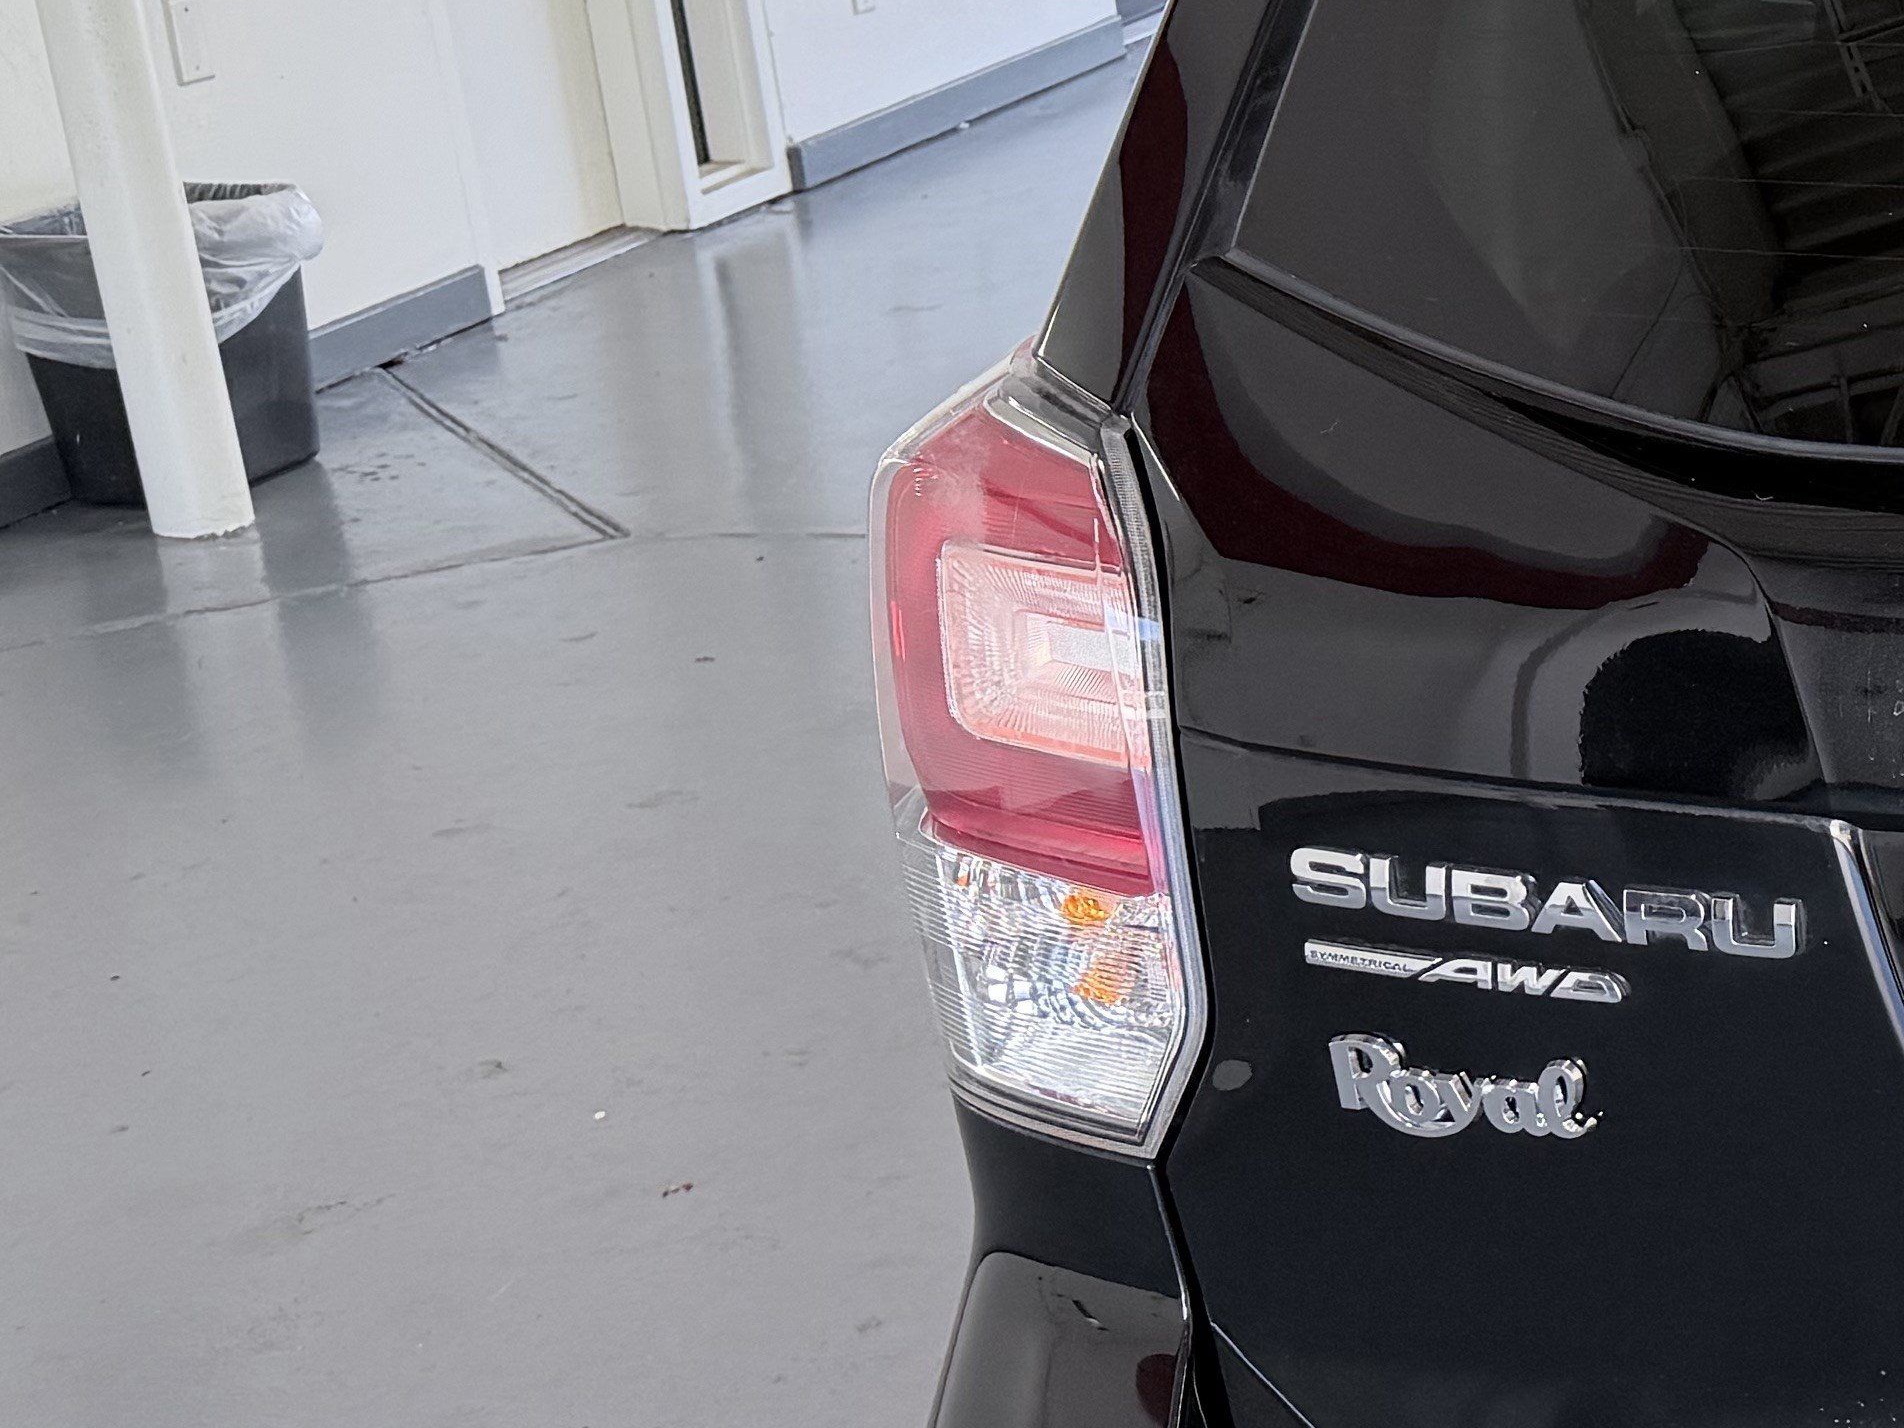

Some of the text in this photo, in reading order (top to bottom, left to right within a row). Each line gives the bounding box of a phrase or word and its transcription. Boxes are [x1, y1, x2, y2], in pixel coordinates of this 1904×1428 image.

[1289, 846, 1808, 960] SUBARU
[1308, 949, 1632, 1004] SYMMETRICAL AWD
[1328, 1031, 1605, 1140] Royal
